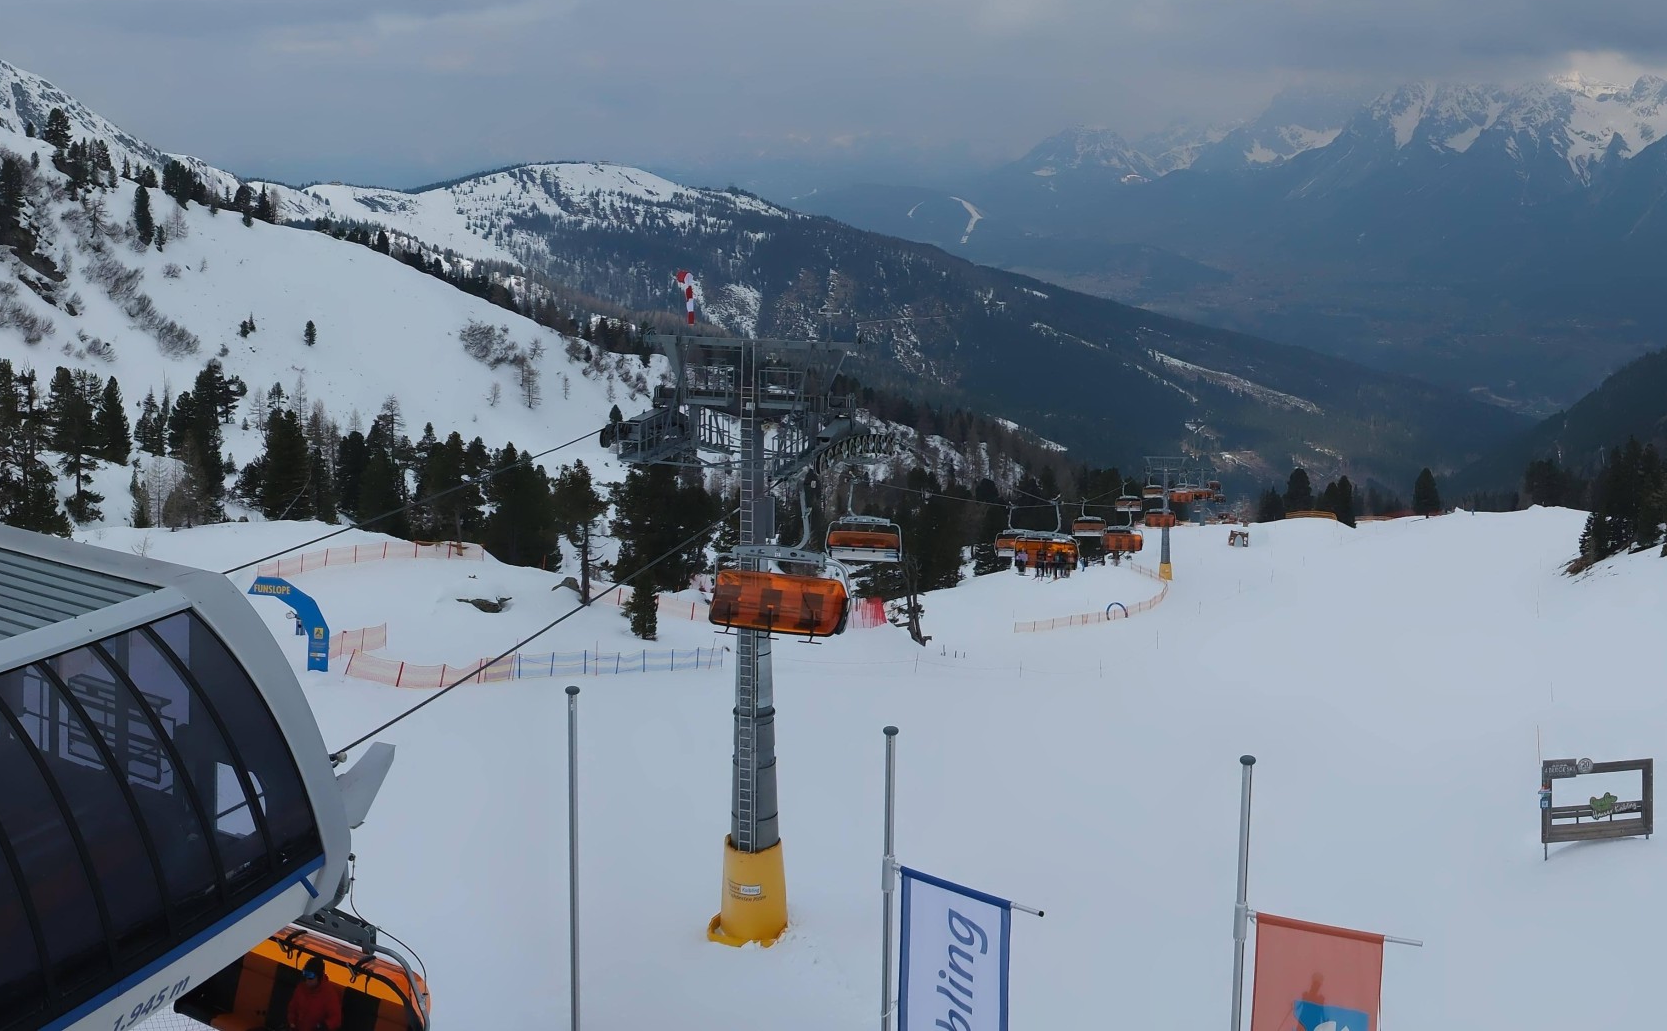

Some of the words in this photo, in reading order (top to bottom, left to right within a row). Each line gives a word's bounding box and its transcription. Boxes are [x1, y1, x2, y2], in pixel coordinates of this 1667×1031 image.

[254, 584, 290, 594] FUNSLOPE
[1592, 808, 1613, 819] Hauser
[169, 975, 190, 1000] m
